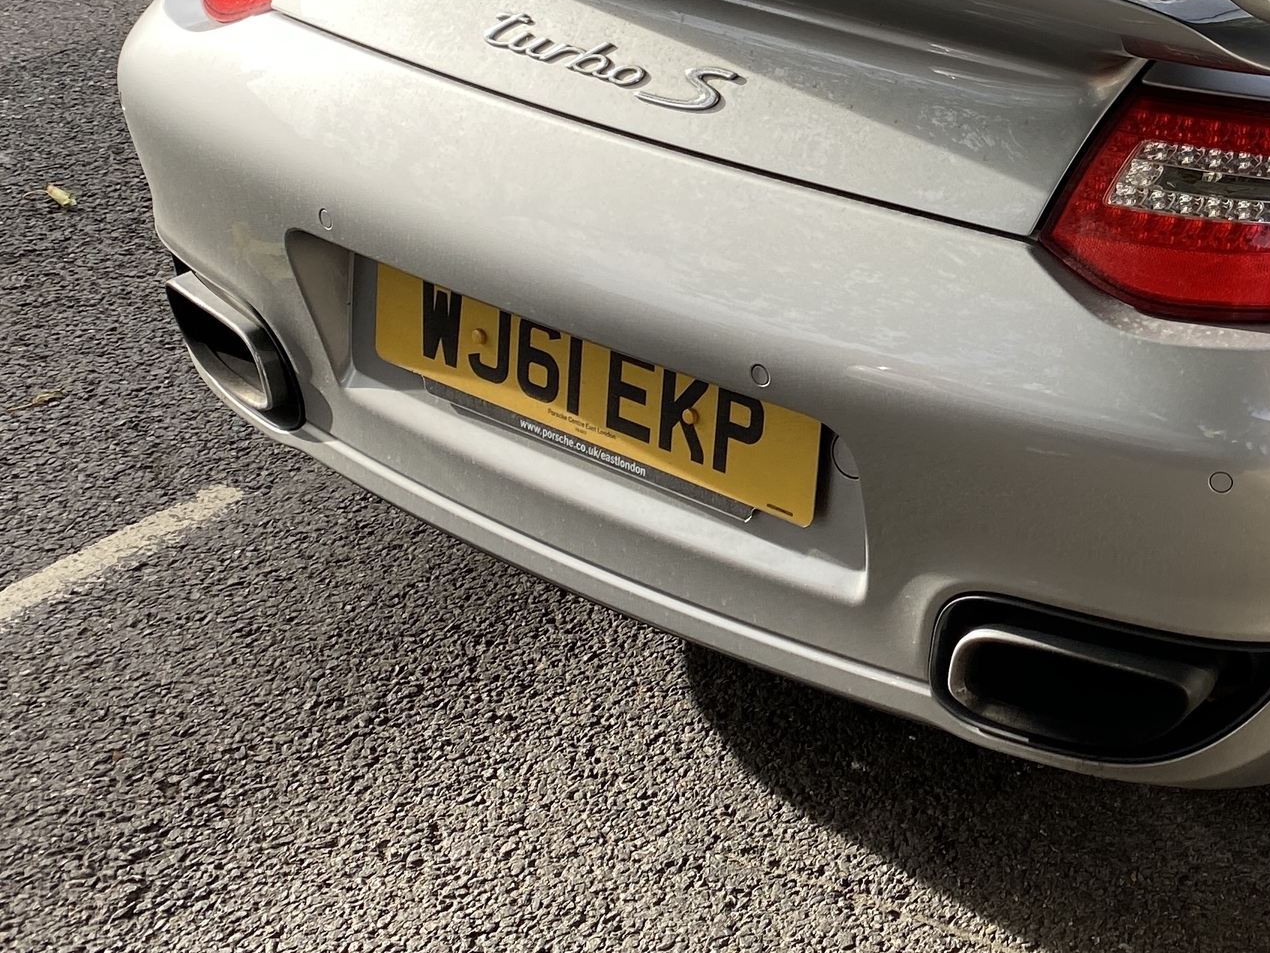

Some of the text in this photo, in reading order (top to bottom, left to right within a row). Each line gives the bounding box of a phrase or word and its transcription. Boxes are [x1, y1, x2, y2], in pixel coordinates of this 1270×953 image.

[484, 12, 740, 111] turbo S
[421, 280, 766, 475] WJ61 EKP
[519, 419, 647, 477] www.porsche.co.uk/eastlondon
[585, 422, 597, 433] East
